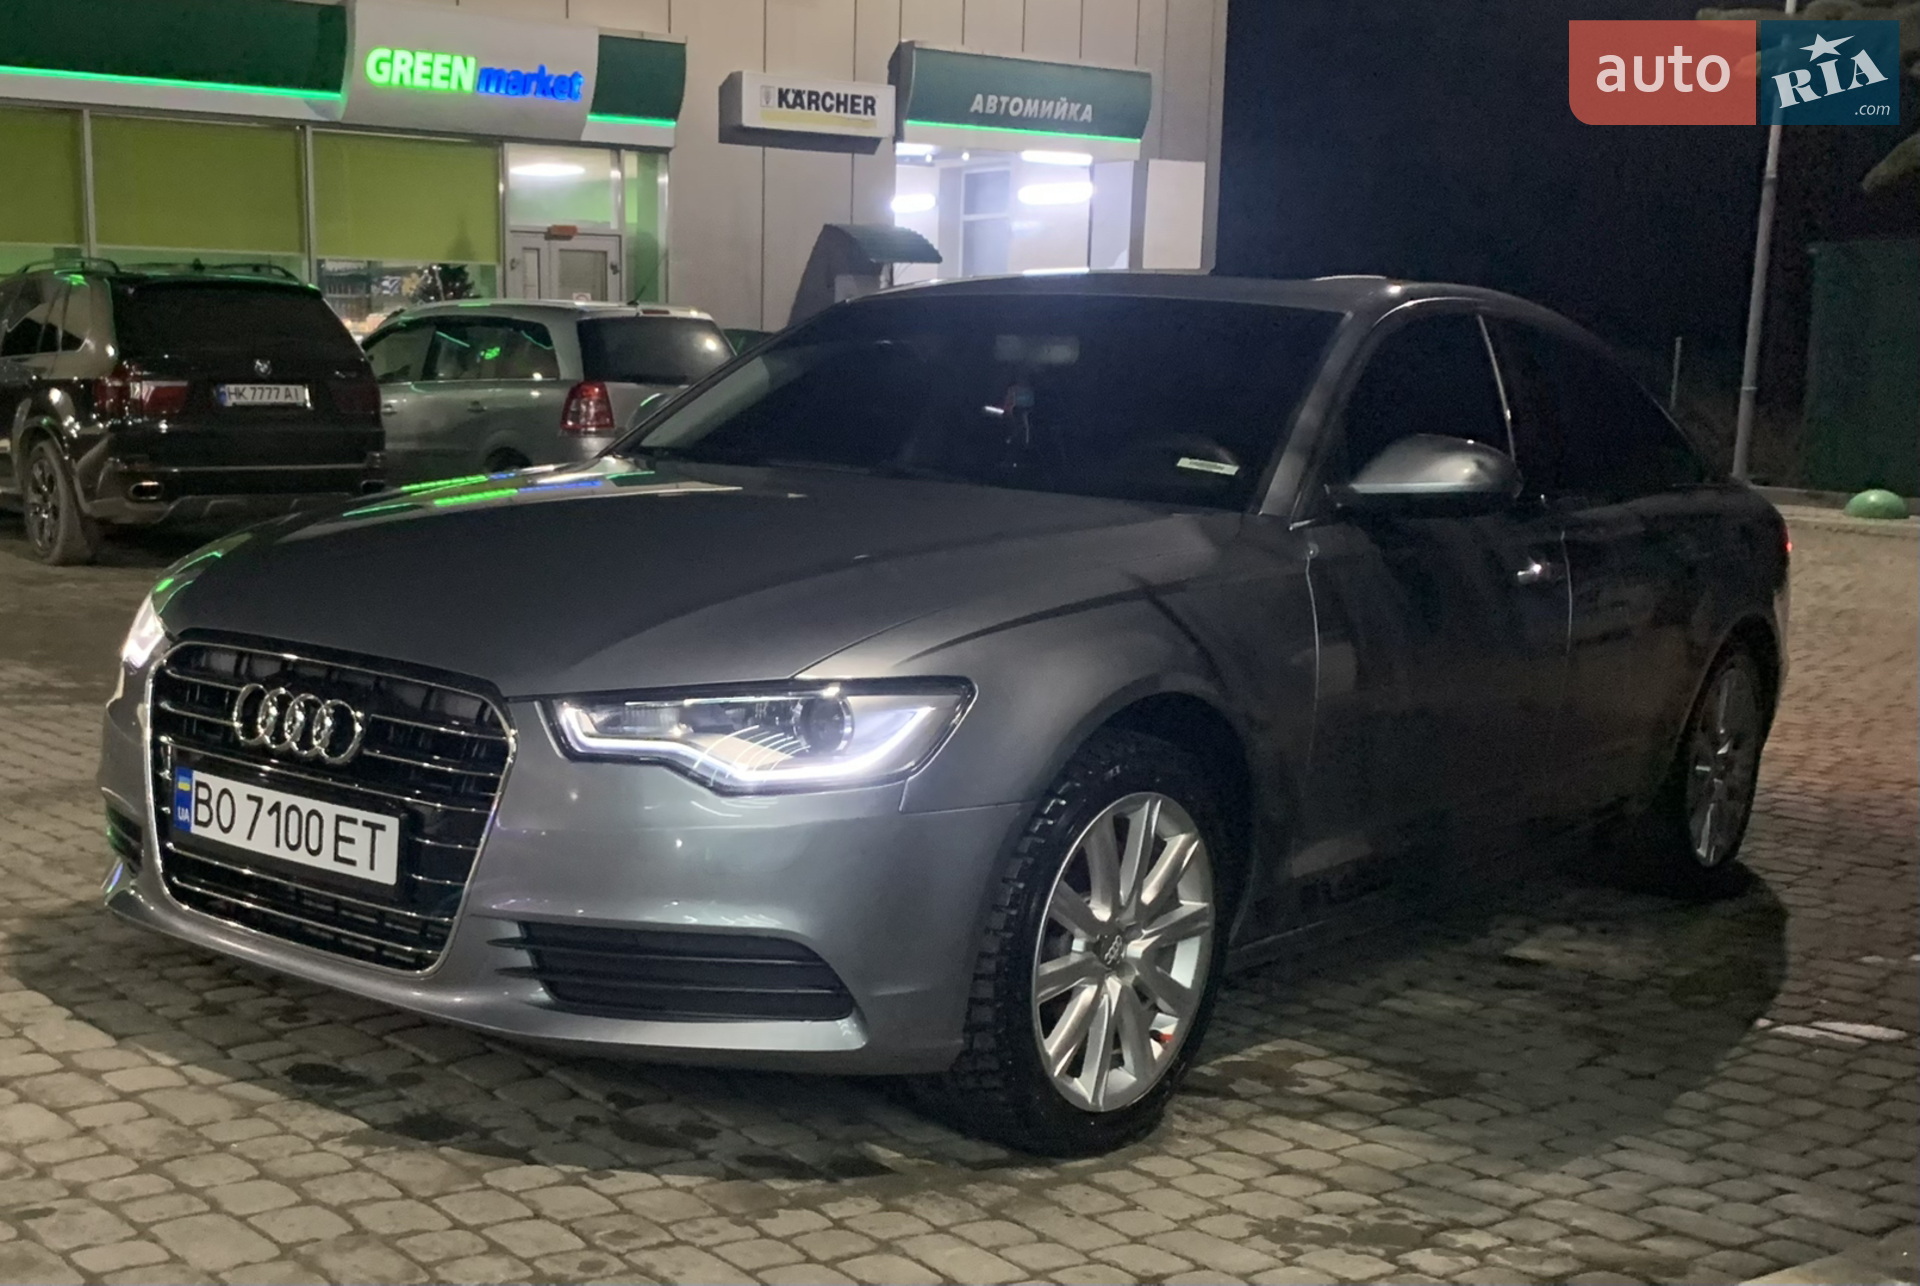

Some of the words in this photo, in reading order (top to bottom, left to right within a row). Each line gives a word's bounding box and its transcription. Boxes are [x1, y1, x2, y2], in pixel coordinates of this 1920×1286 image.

[365, 47, 476, 92] GREEN
[477, 64, 584, 101] market
[970, 93, 1093, 123] АВТОМИЙКА
[249, 386, 280, 401] 7777
[178, 805, 191, 823] UA
[194, 780, 236, 835] BO
[246, 793, 324, 857] 7100
[333, 813, 386, 871] ET
